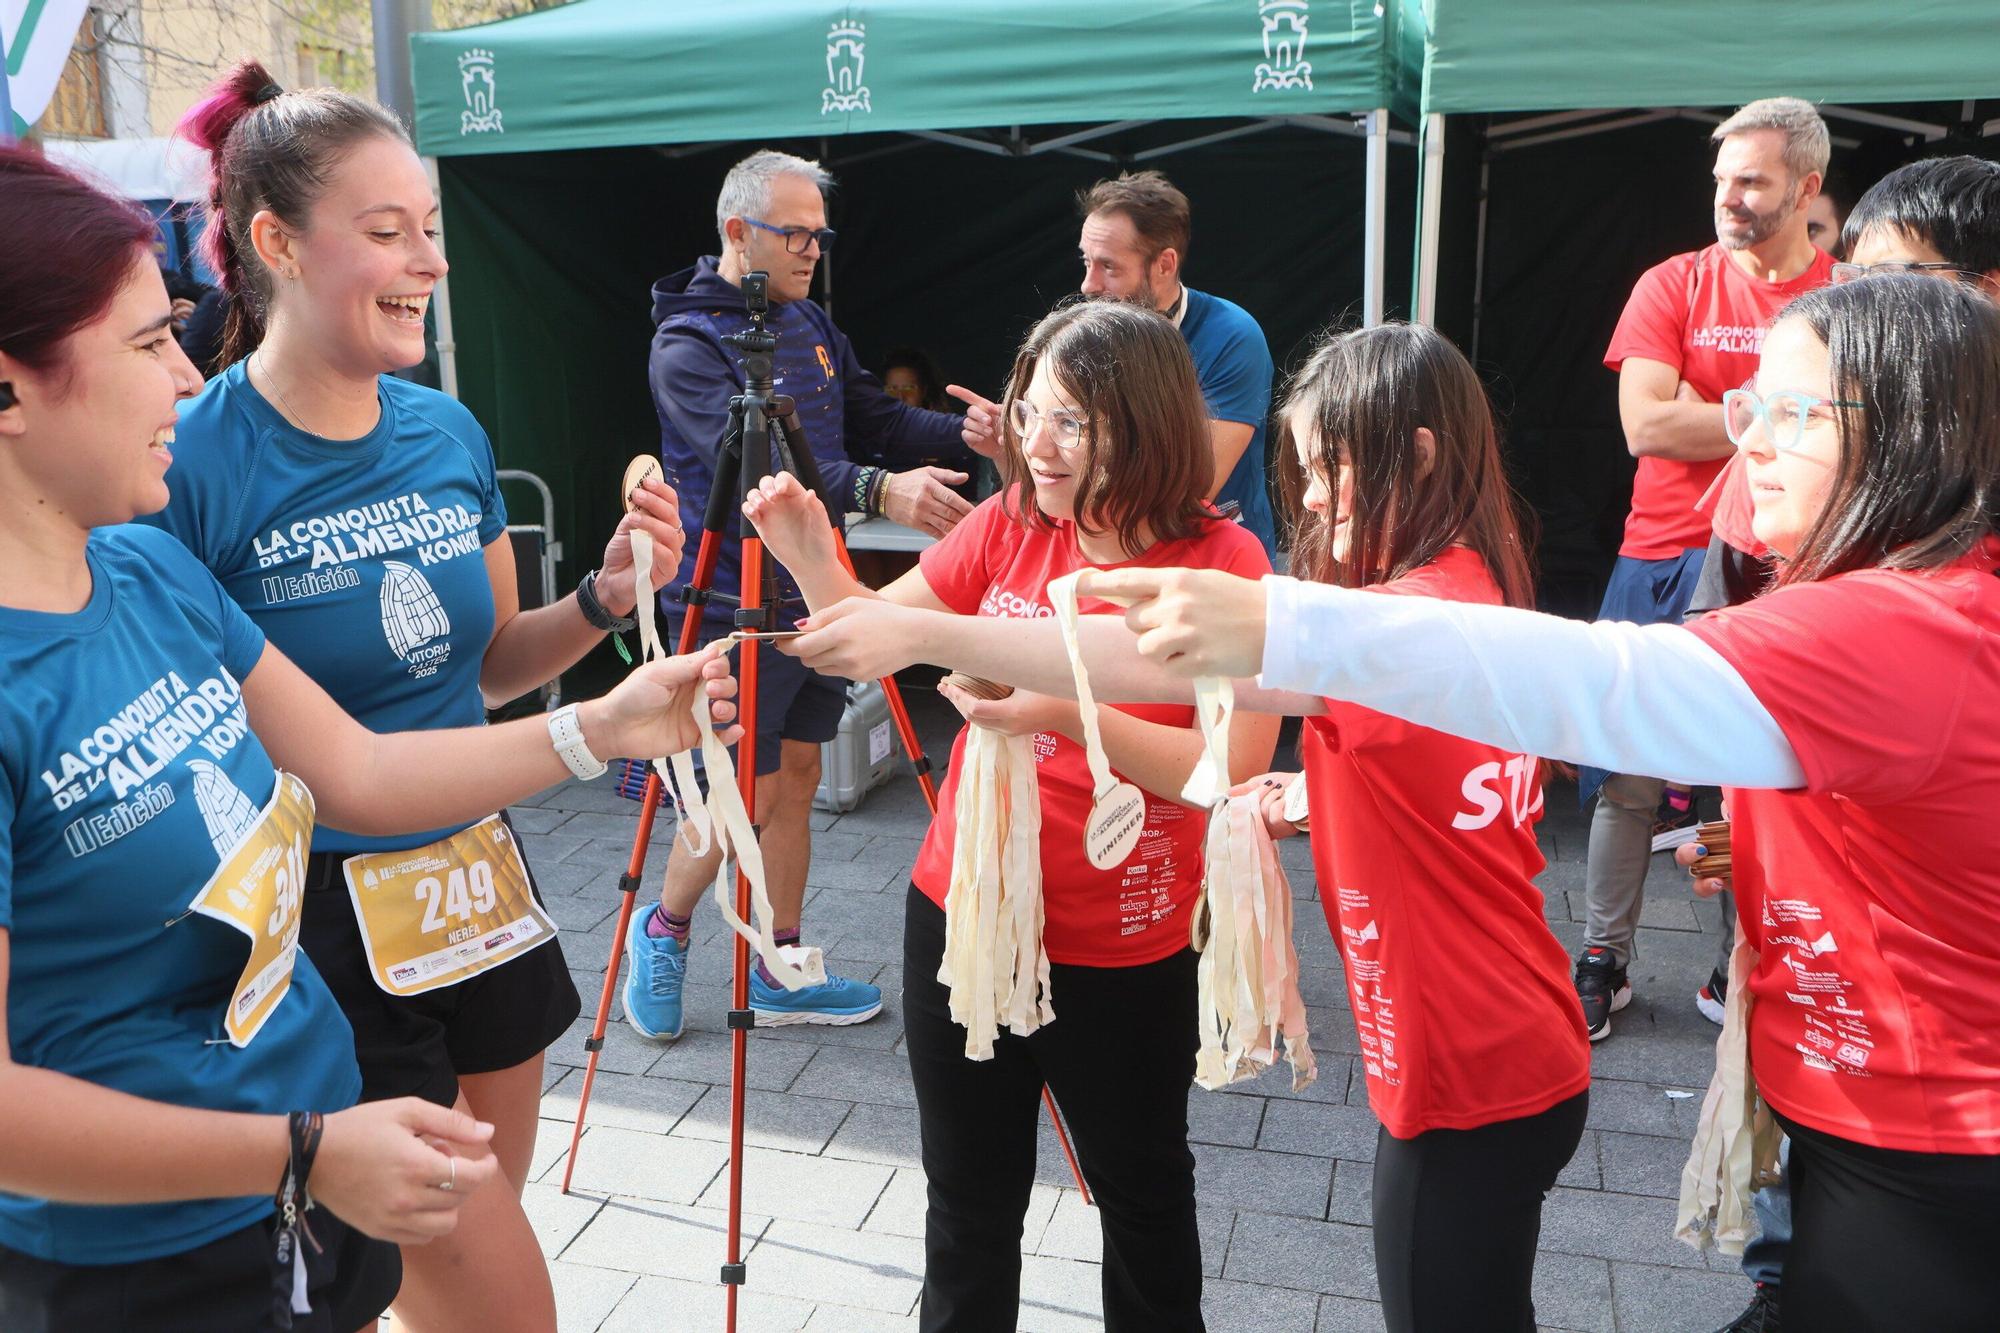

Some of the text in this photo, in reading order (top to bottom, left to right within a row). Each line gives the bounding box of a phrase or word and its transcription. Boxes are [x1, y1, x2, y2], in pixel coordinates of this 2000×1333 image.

[1693, 327, 1709, 338] LA
[252, 492, 431, 557] LA CONQUISTA
[259, 553, 282, 569] DE
[285, 544, 310, 560] LA
[311, 504, 472, 569] ALMENDRA
[262, 565, 361, 604] II Edición
[407, 642, 451, 664] VITORIA
[408, 652, 450, 674] GASTEIZ
[415, 665, 438, 680] 2025
[41, 671, 190, 796] LA CONQUISTA
[51, 665, 241, 812] DE LA ALMENDRA
[1032, 732, 1057, 746] ORIA
[64, 781, 176, 859] II Edición
[1097, 811, 1143, 861] FINISHER
[414, 859, 496, 934] 249
[1120, 900, 1149, 913] udapa
[448, 924, 481, 945] NEREA
[1767, 935, 1812, 952] LABORAL
